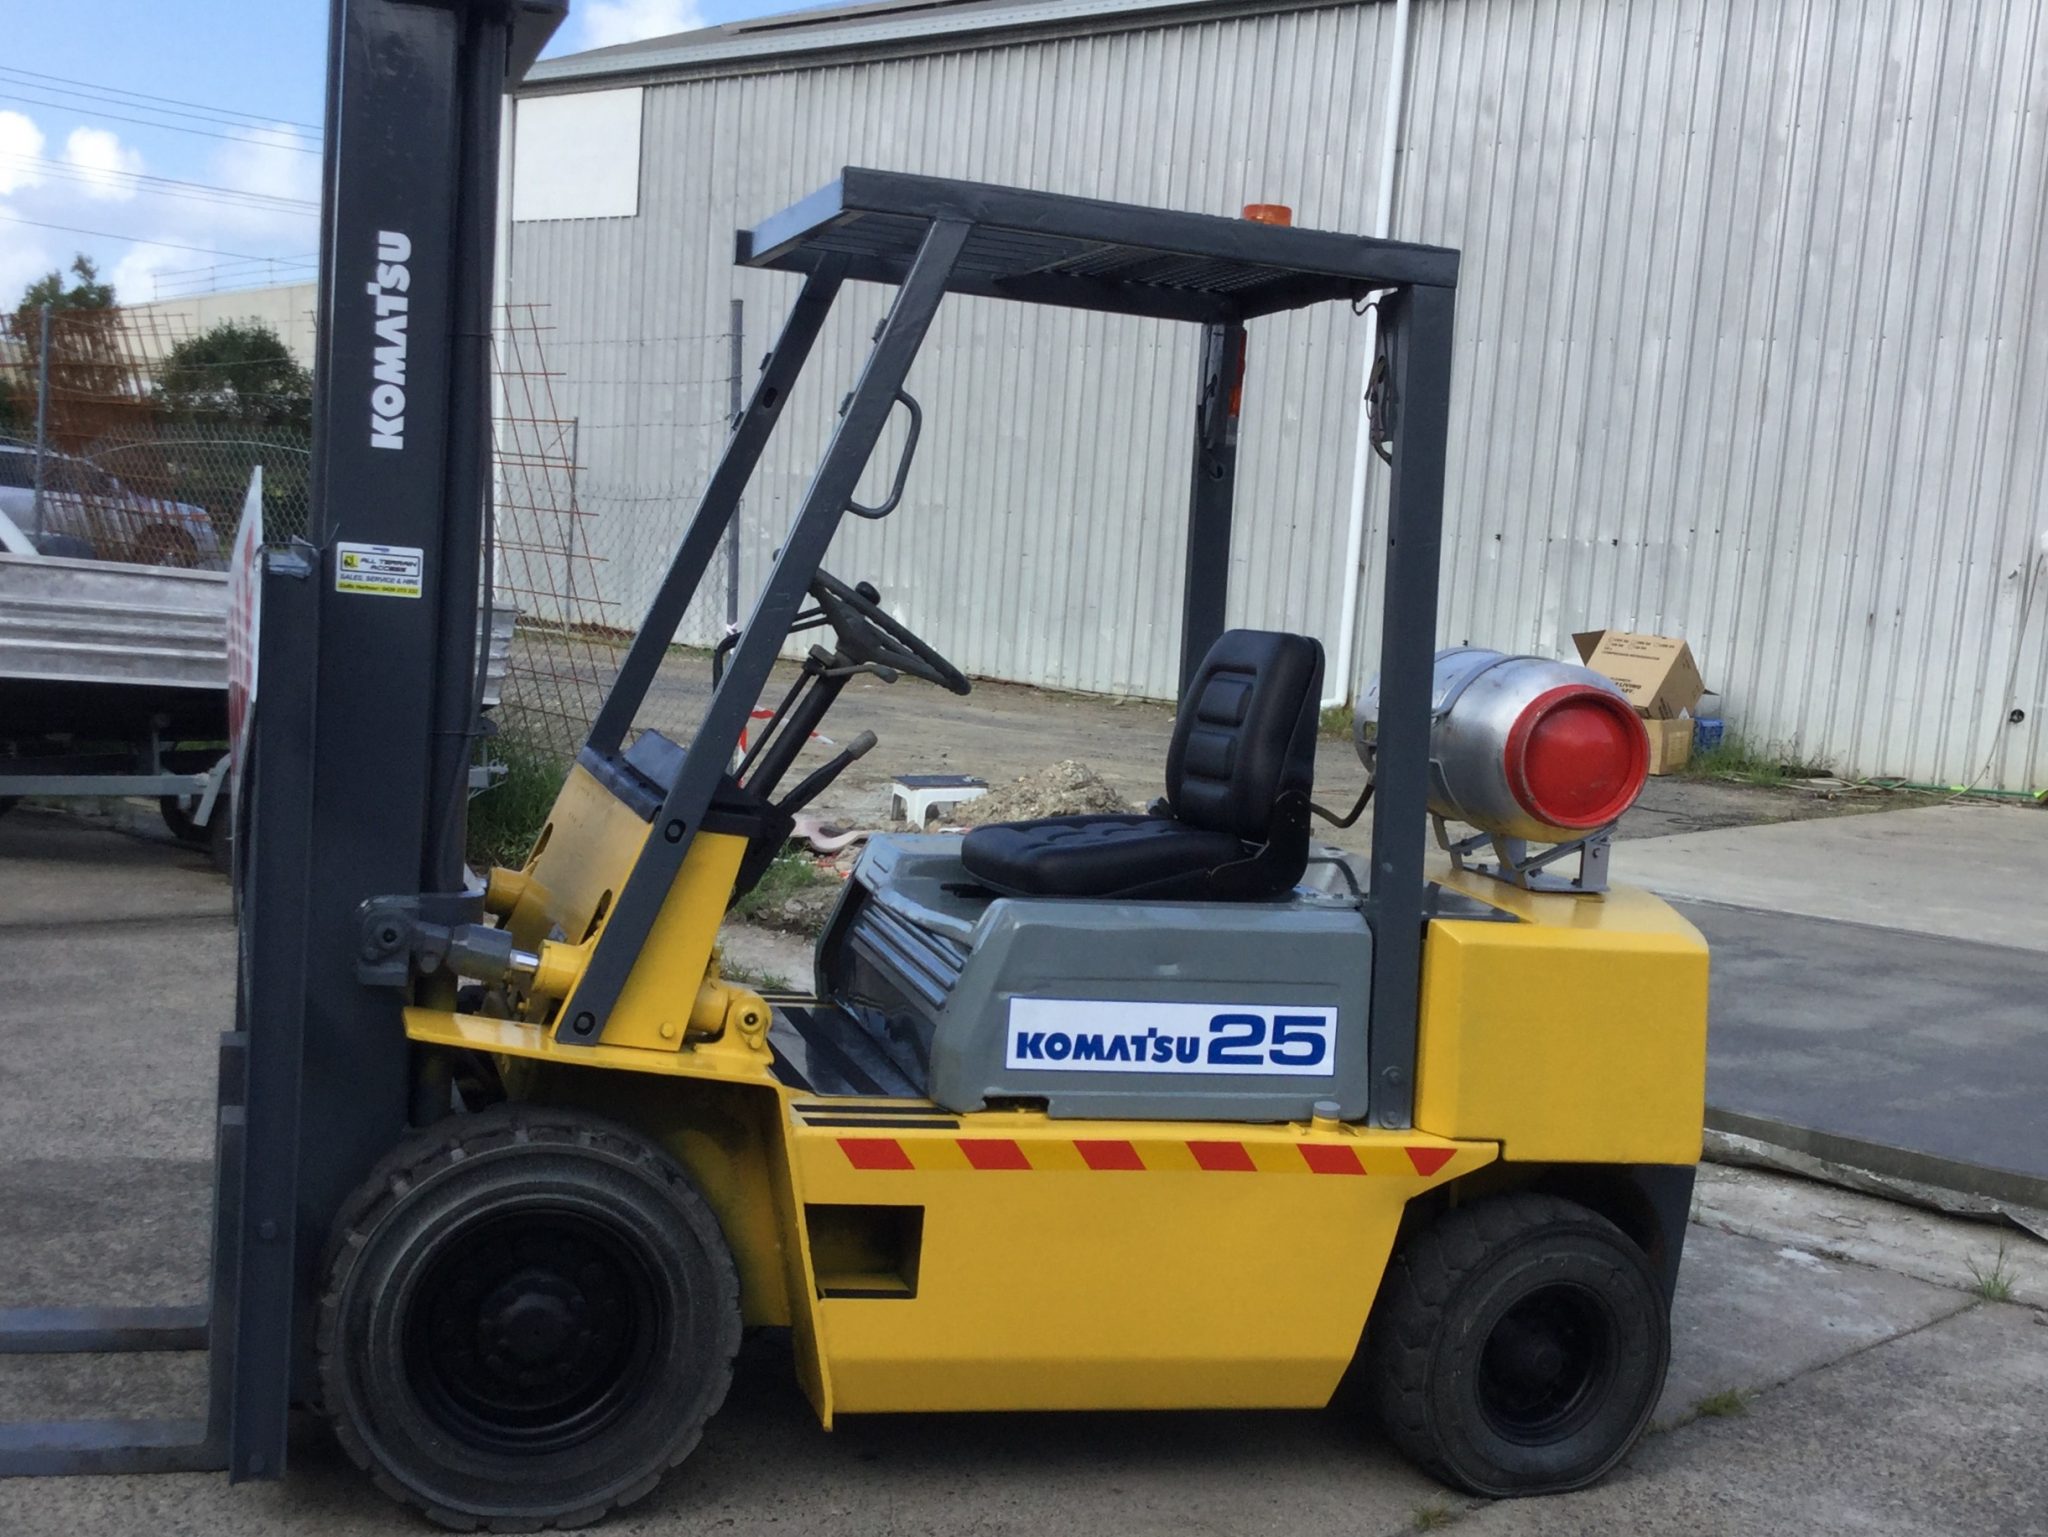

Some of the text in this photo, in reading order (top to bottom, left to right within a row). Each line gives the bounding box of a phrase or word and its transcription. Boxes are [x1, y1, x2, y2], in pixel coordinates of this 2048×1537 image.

[366, 230, 412, 450] KOMATSU
[366, 575, 395, 584] SERVICE
[402, 578, 418, 586] HIRE
[1015, 1013, 1327, 1066] KOMATSU 25
